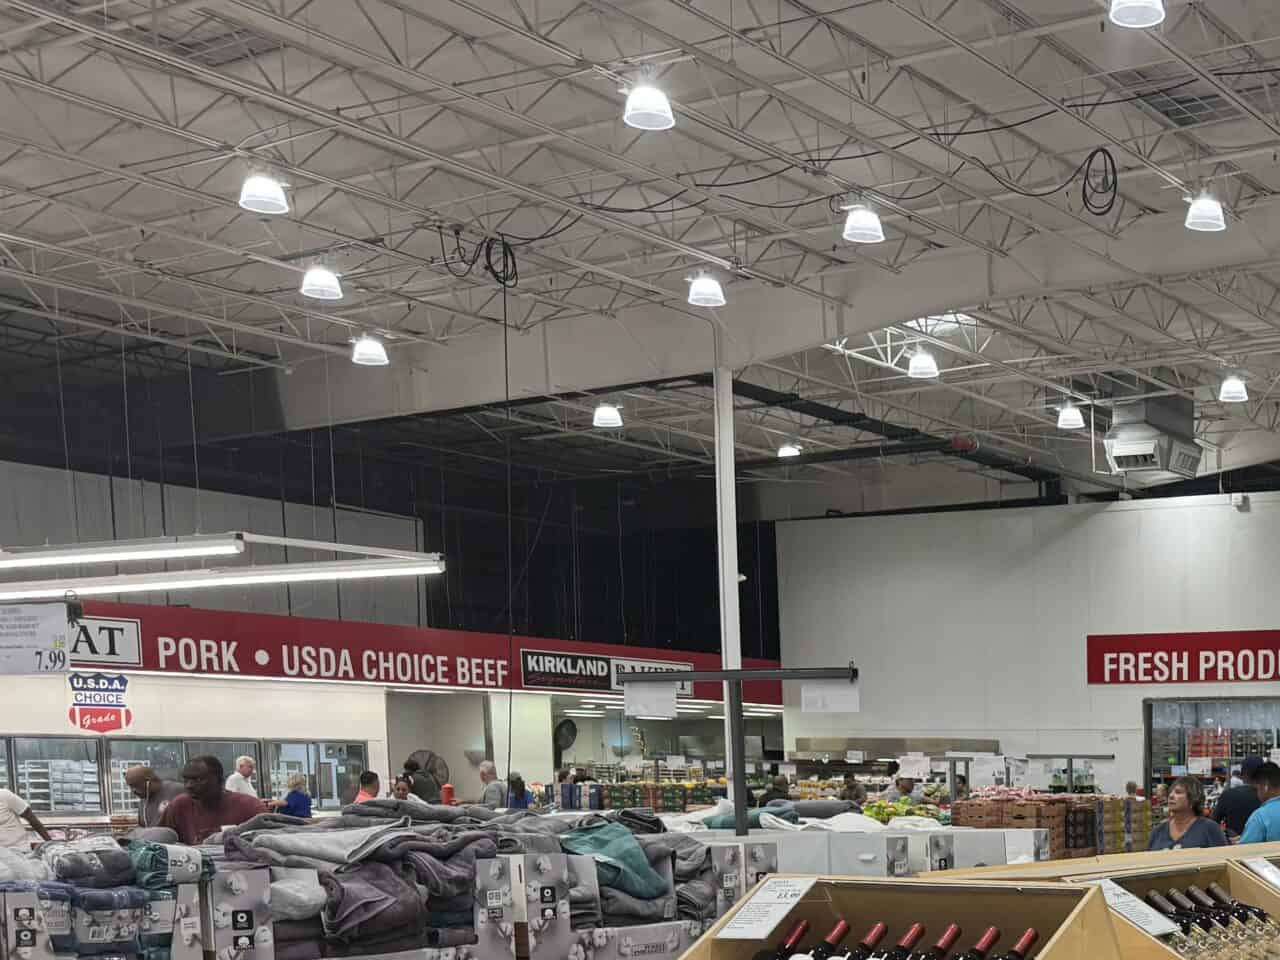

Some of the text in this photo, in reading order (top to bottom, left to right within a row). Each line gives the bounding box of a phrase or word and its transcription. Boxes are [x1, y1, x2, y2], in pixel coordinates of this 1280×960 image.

[70, 624, 124, 657] AT
[35, 650, 66, 671] 7.99
[157, 636, 240, 672] PORK
[282, 644, 508, 687] USDA CHOICE BEEF
[527, 655, 608, 677] KIRKLAND
[1103, 651, 1189, 682] FRESH
[73, 678, 125, 690] U.S.D.A.
[74, 692, 124, 704] CHOICE
[82, 711, 117, 729] Grade
